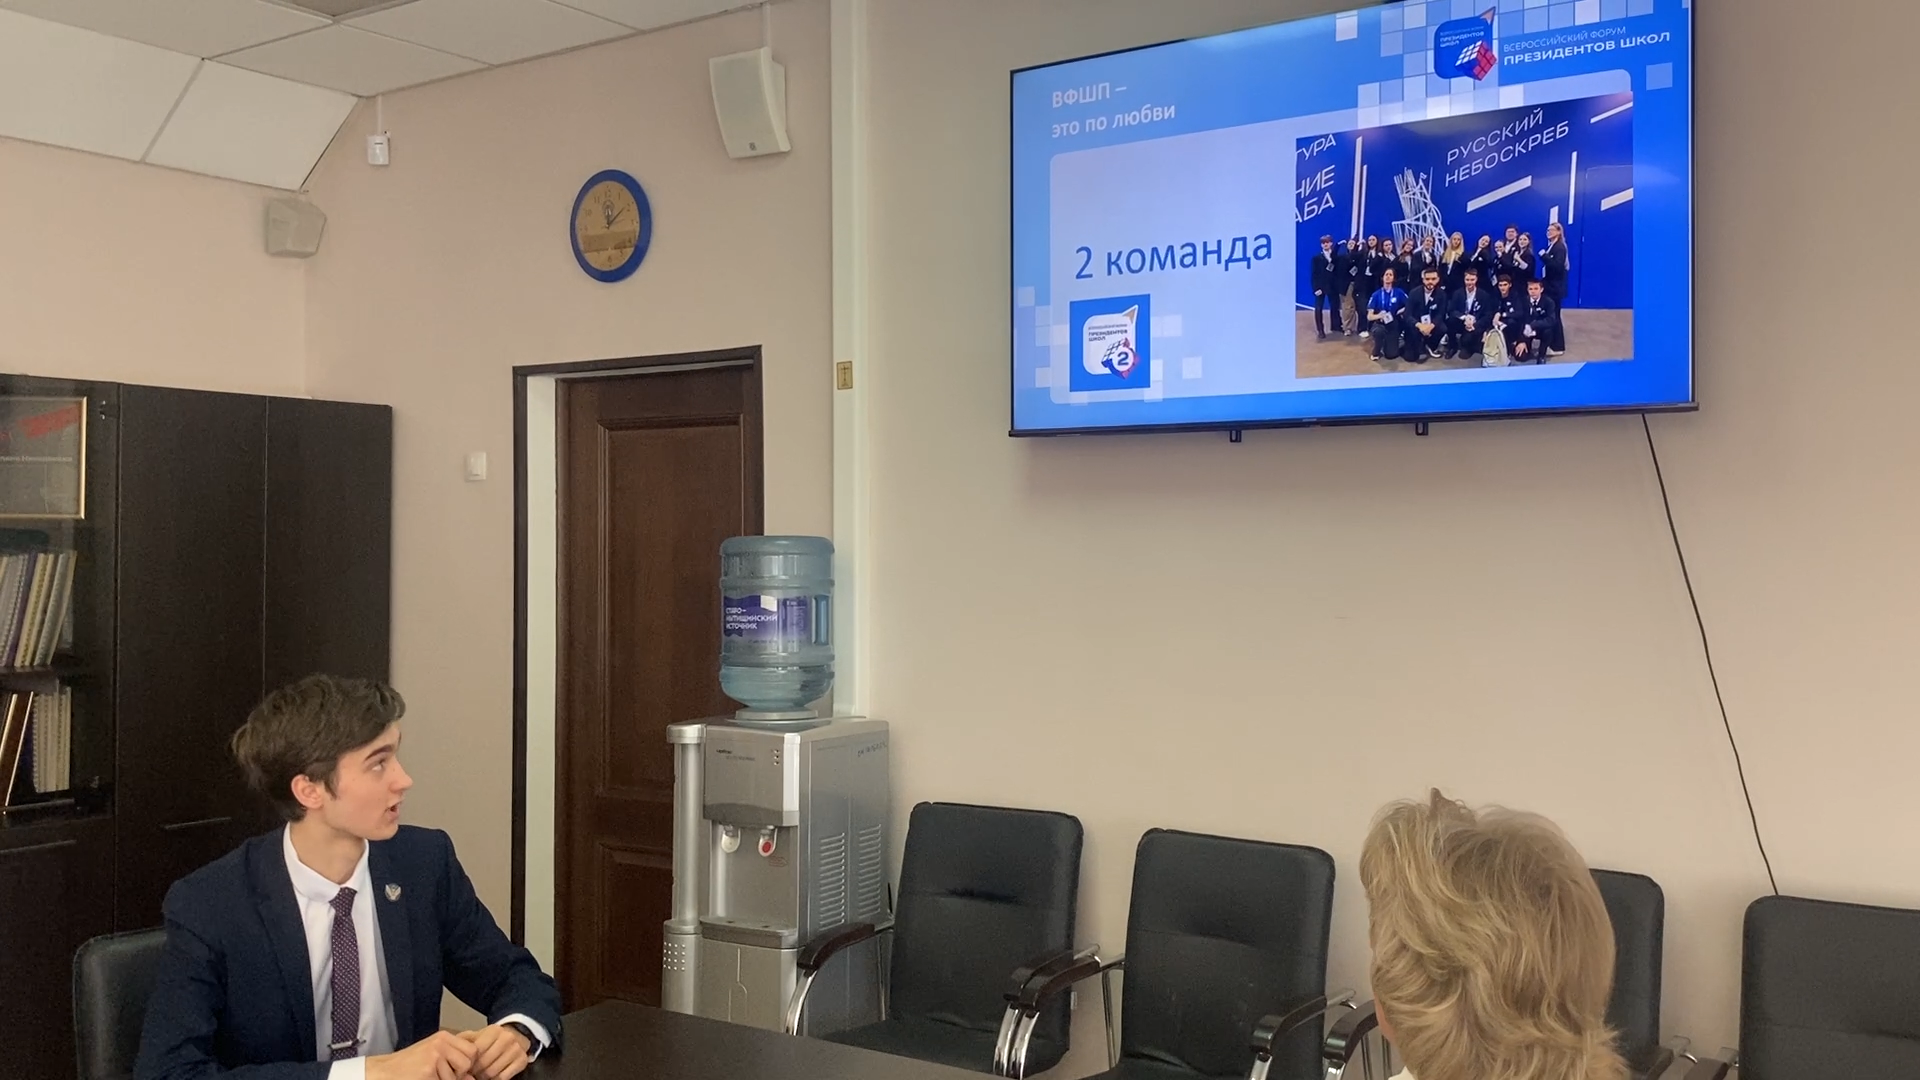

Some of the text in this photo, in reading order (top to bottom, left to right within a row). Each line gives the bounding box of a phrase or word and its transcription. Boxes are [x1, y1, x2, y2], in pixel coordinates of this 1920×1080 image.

[1503, 31, 1671, 66] ПРЕЗИДЕНТОВ ШКОЛ
[1504, 30, 1589, 53] ВСЕРОССИЙСКИЙ
[1590, 26, 1626, 41] ФОРУМ
[1052, 82, 1110, 108] ВФШП
[1051, 103, 1175, 138] это по любви
[1446, 107, 1544, 165] РУССКИЙ
[1445, 120, 1570, 187] НЕБОСКРЕБ
[1075, 233, 1273, 279] 2 команда
[1117, 351, 1129, 366] 2
